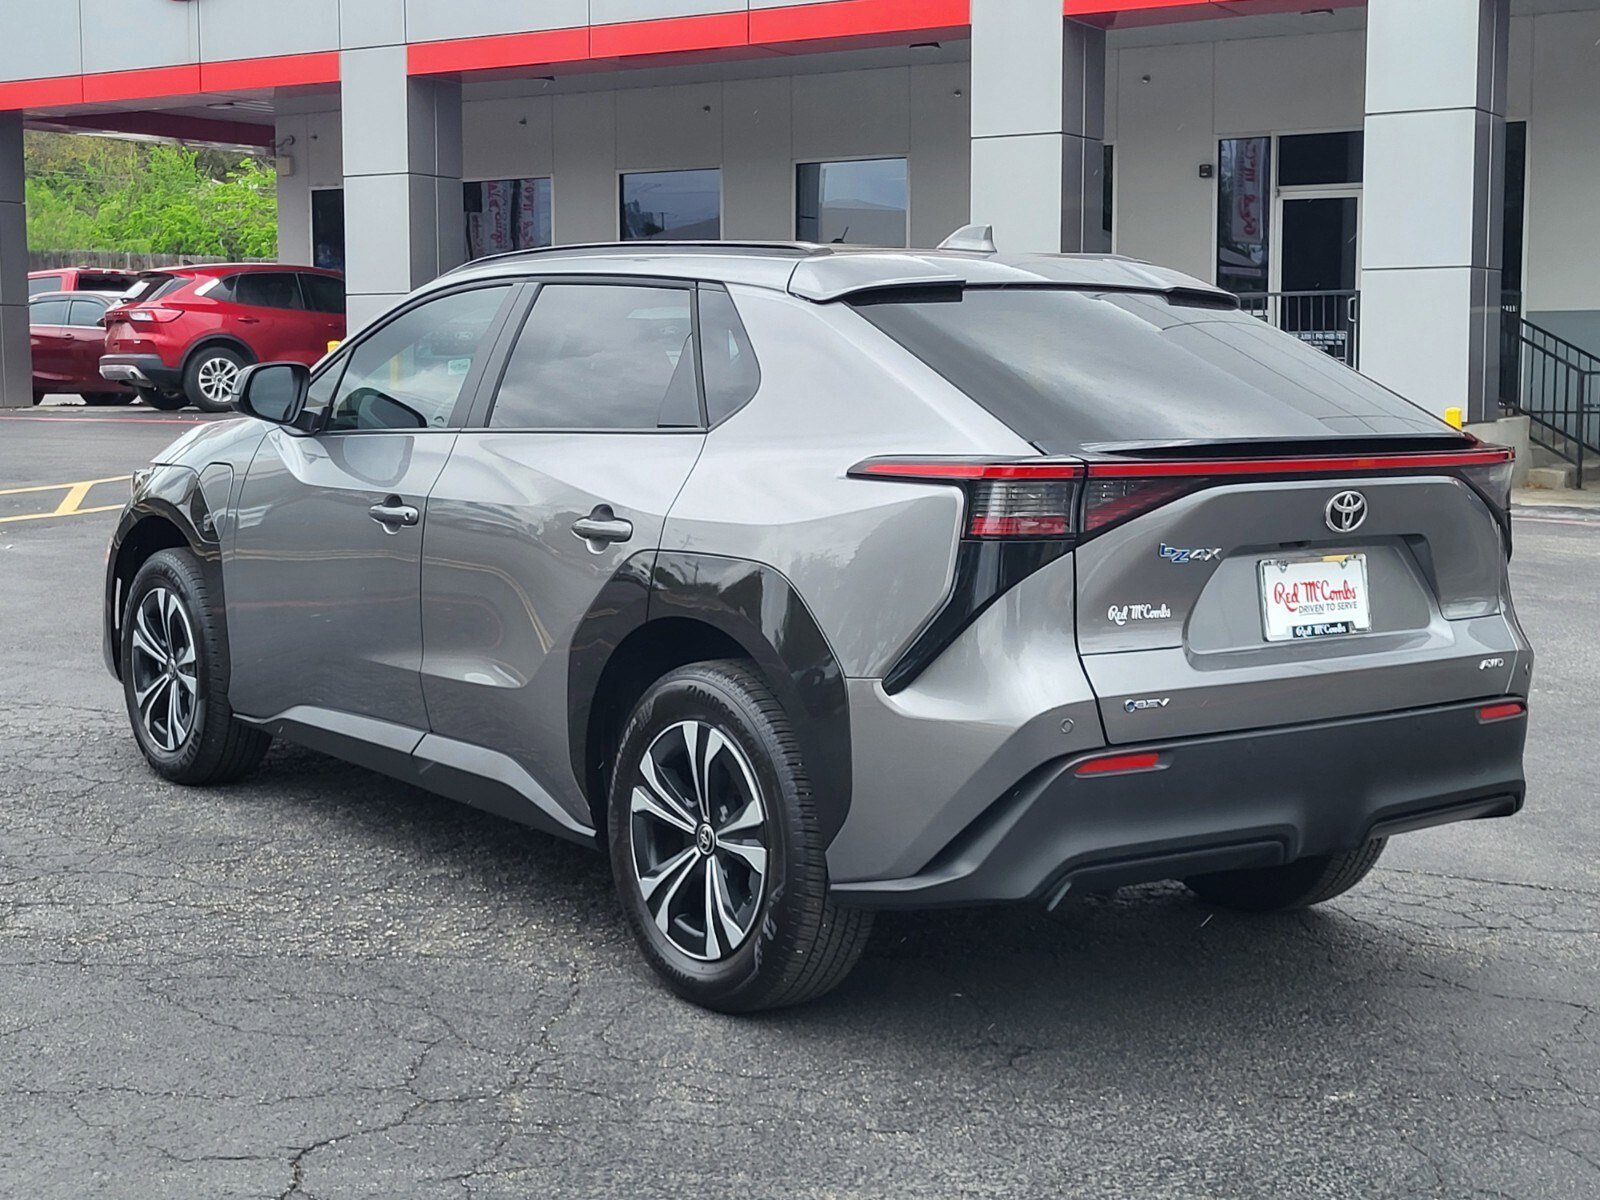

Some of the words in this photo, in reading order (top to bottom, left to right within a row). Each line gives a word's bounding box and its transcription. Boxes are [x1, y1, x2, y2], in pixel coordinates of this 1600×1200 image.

[1273, 582, 1300, 613] Red
[1301, 580, 1357, 603] McCombs
[1298, 604, 1325, 614] DRIVEN
[1326, 603, 1336, 611] TO
[1337, 601, 1358, 611] SERVE
[1107, 604, 1128, 626] Red
[1129, 603, 1171, 620] McCombs
